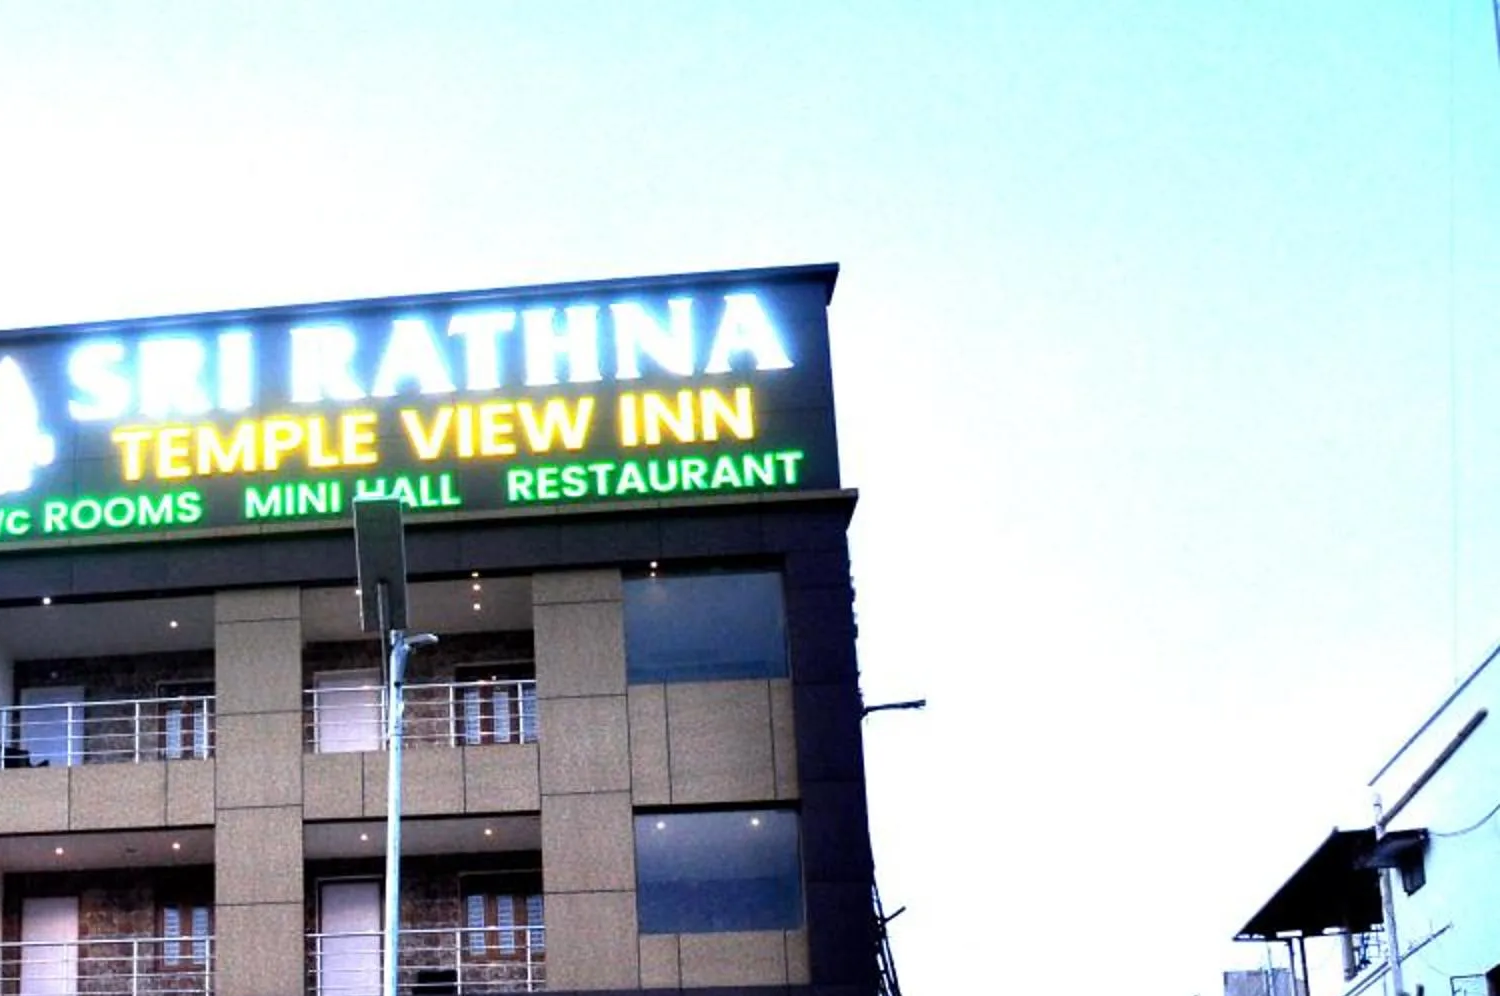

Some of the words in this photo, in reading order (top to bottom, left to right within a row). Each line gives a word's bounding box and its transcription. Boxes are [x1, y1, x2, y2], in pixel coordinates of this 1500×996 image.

[67, 331, 253, 421] SRI
[289, 293, 795, 403] RATHNA
[112, 411, 380, 481] TEMPLE
[401, 397, 595, 461] VIEW
[619, 387, 755, 447] INN
[43, 491, 202, 533] ROOMS
[245, 481, 342, 519] MINI
[507, 450, 804, 502] RESTAURANT
